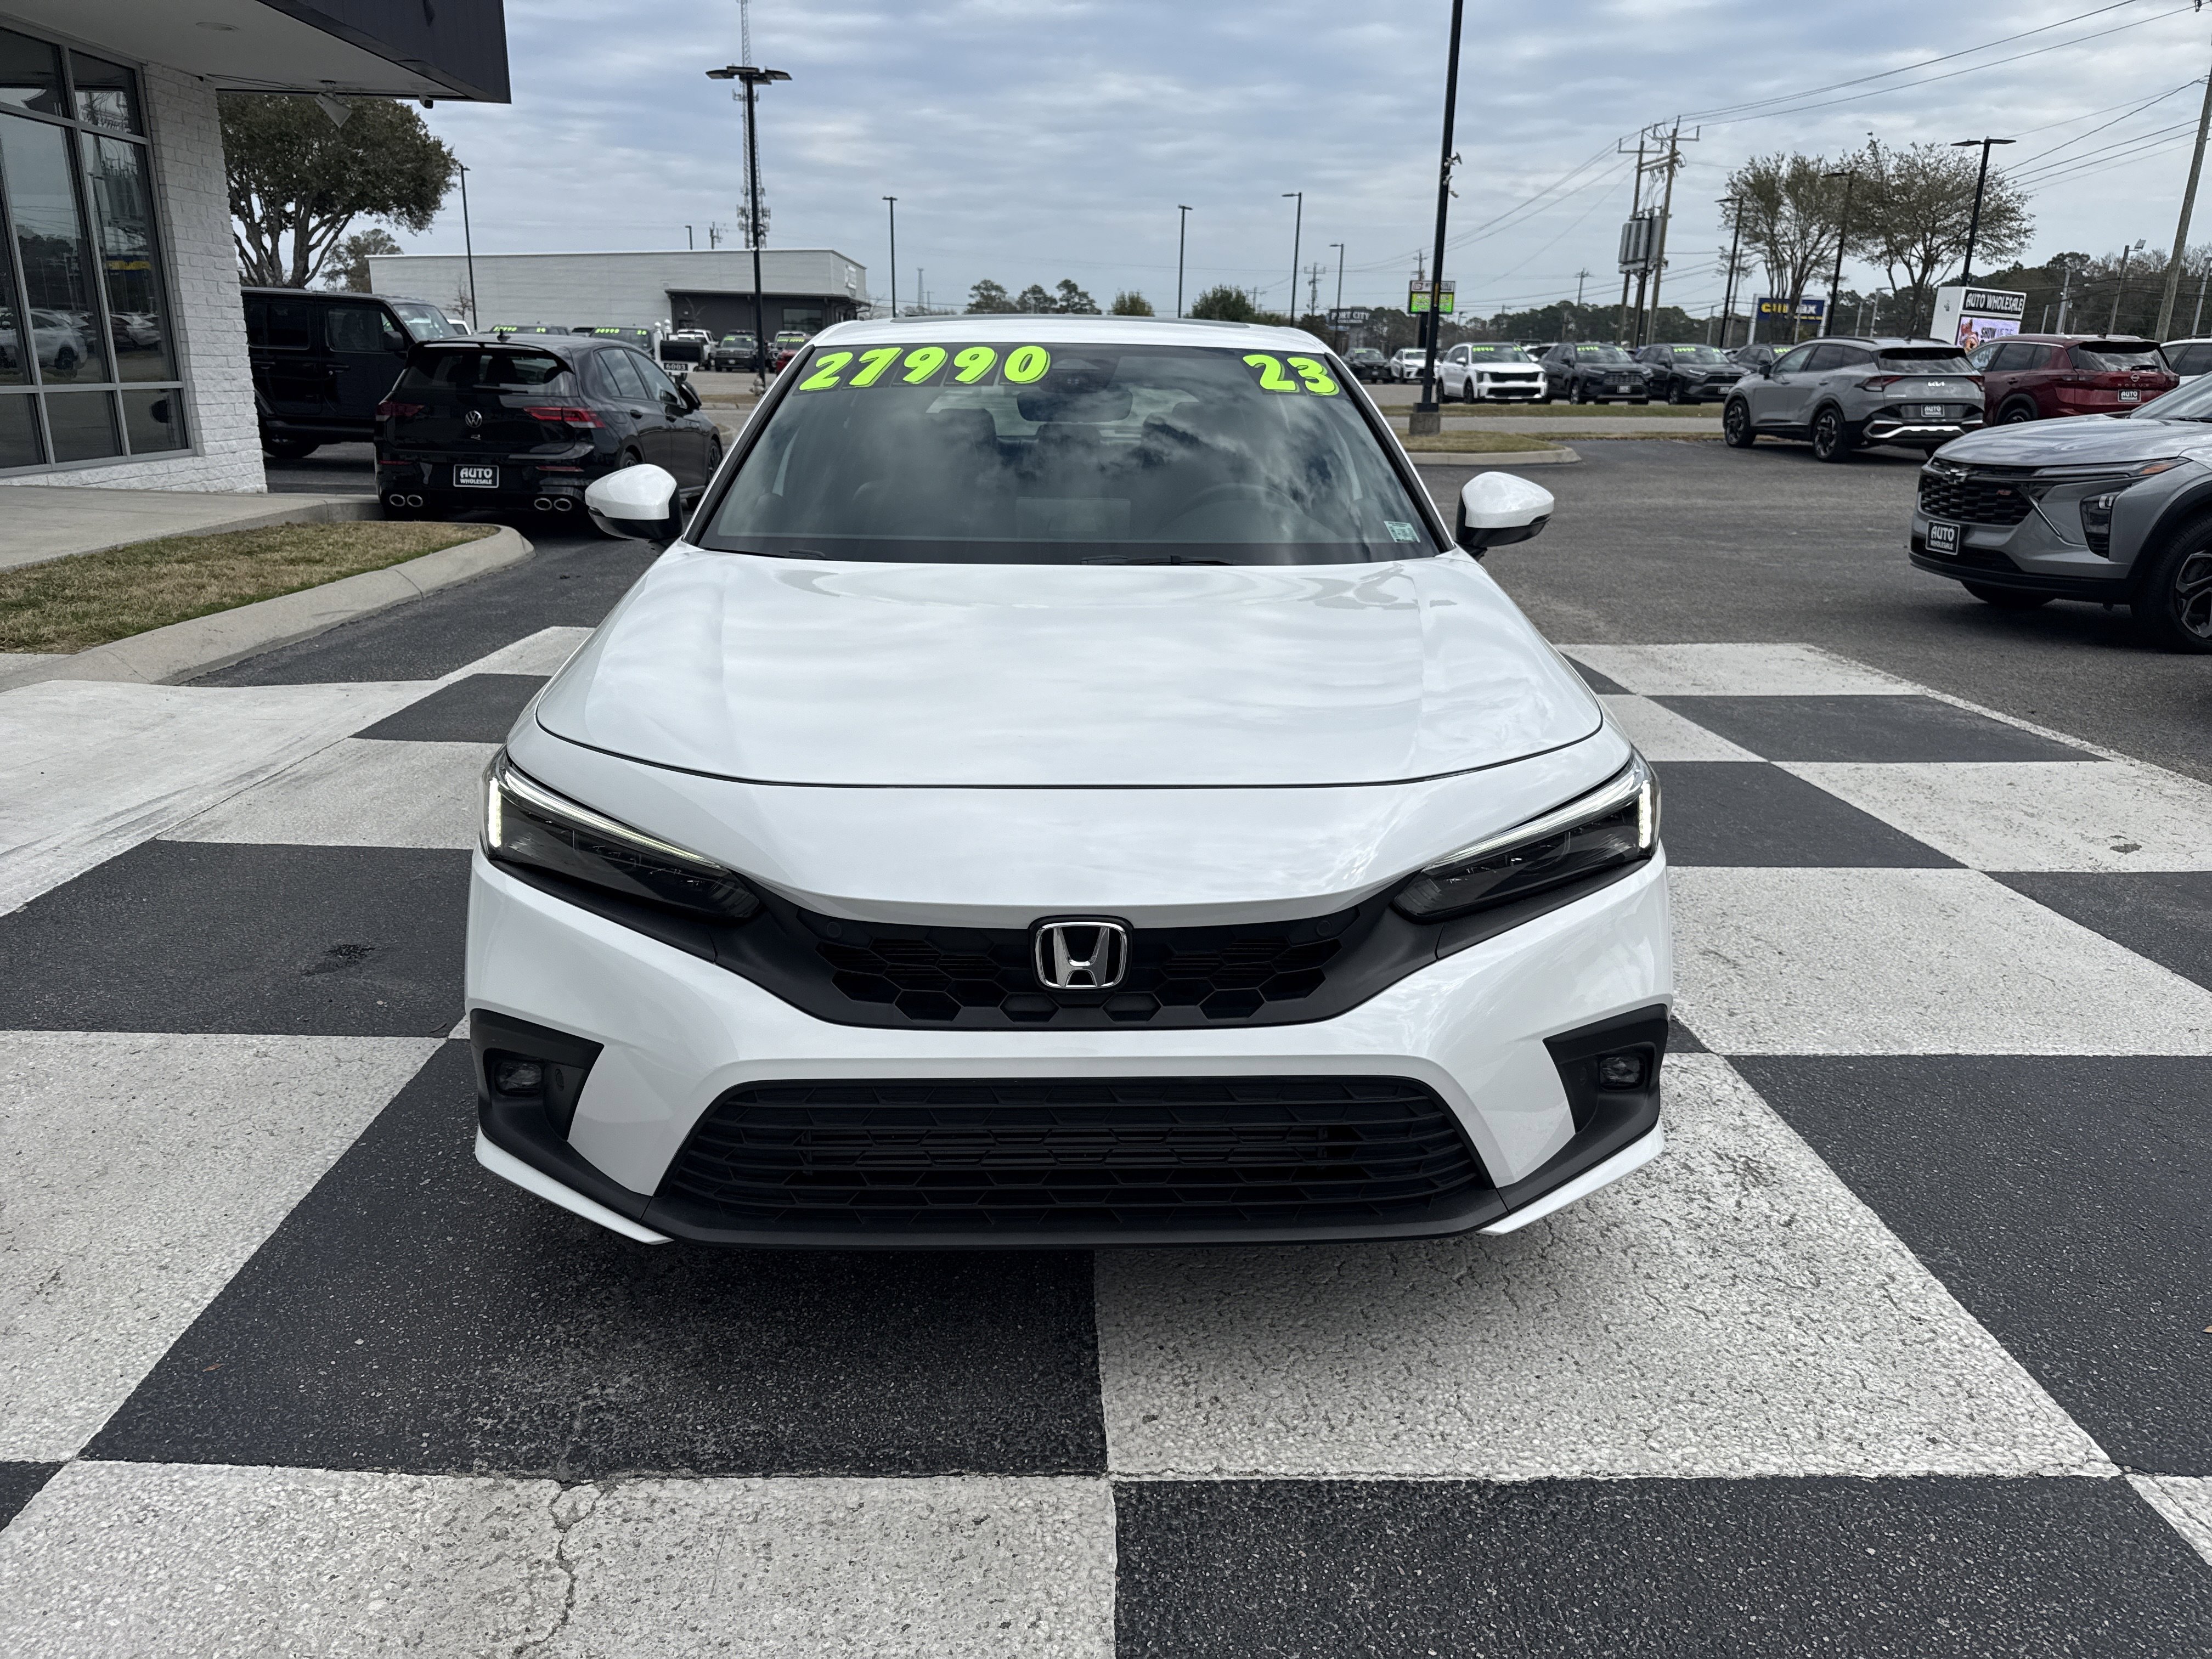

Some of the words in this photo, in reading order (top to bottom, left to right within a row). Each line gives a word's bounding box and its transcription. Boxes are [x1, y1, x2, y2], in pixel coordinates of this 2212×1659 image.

[1966, 292, 1985, 308] AUTO
[1987, 294, 2023, 312] WHOLESALE
[1352, 312, 1370, 320] CITY
[799, 346, 1050, 391] 27990
[1243, 354, 1339, 396] 23
[460, 468, 493, 478] AUTO
[1931, 526, 1955, 541] AUTO
